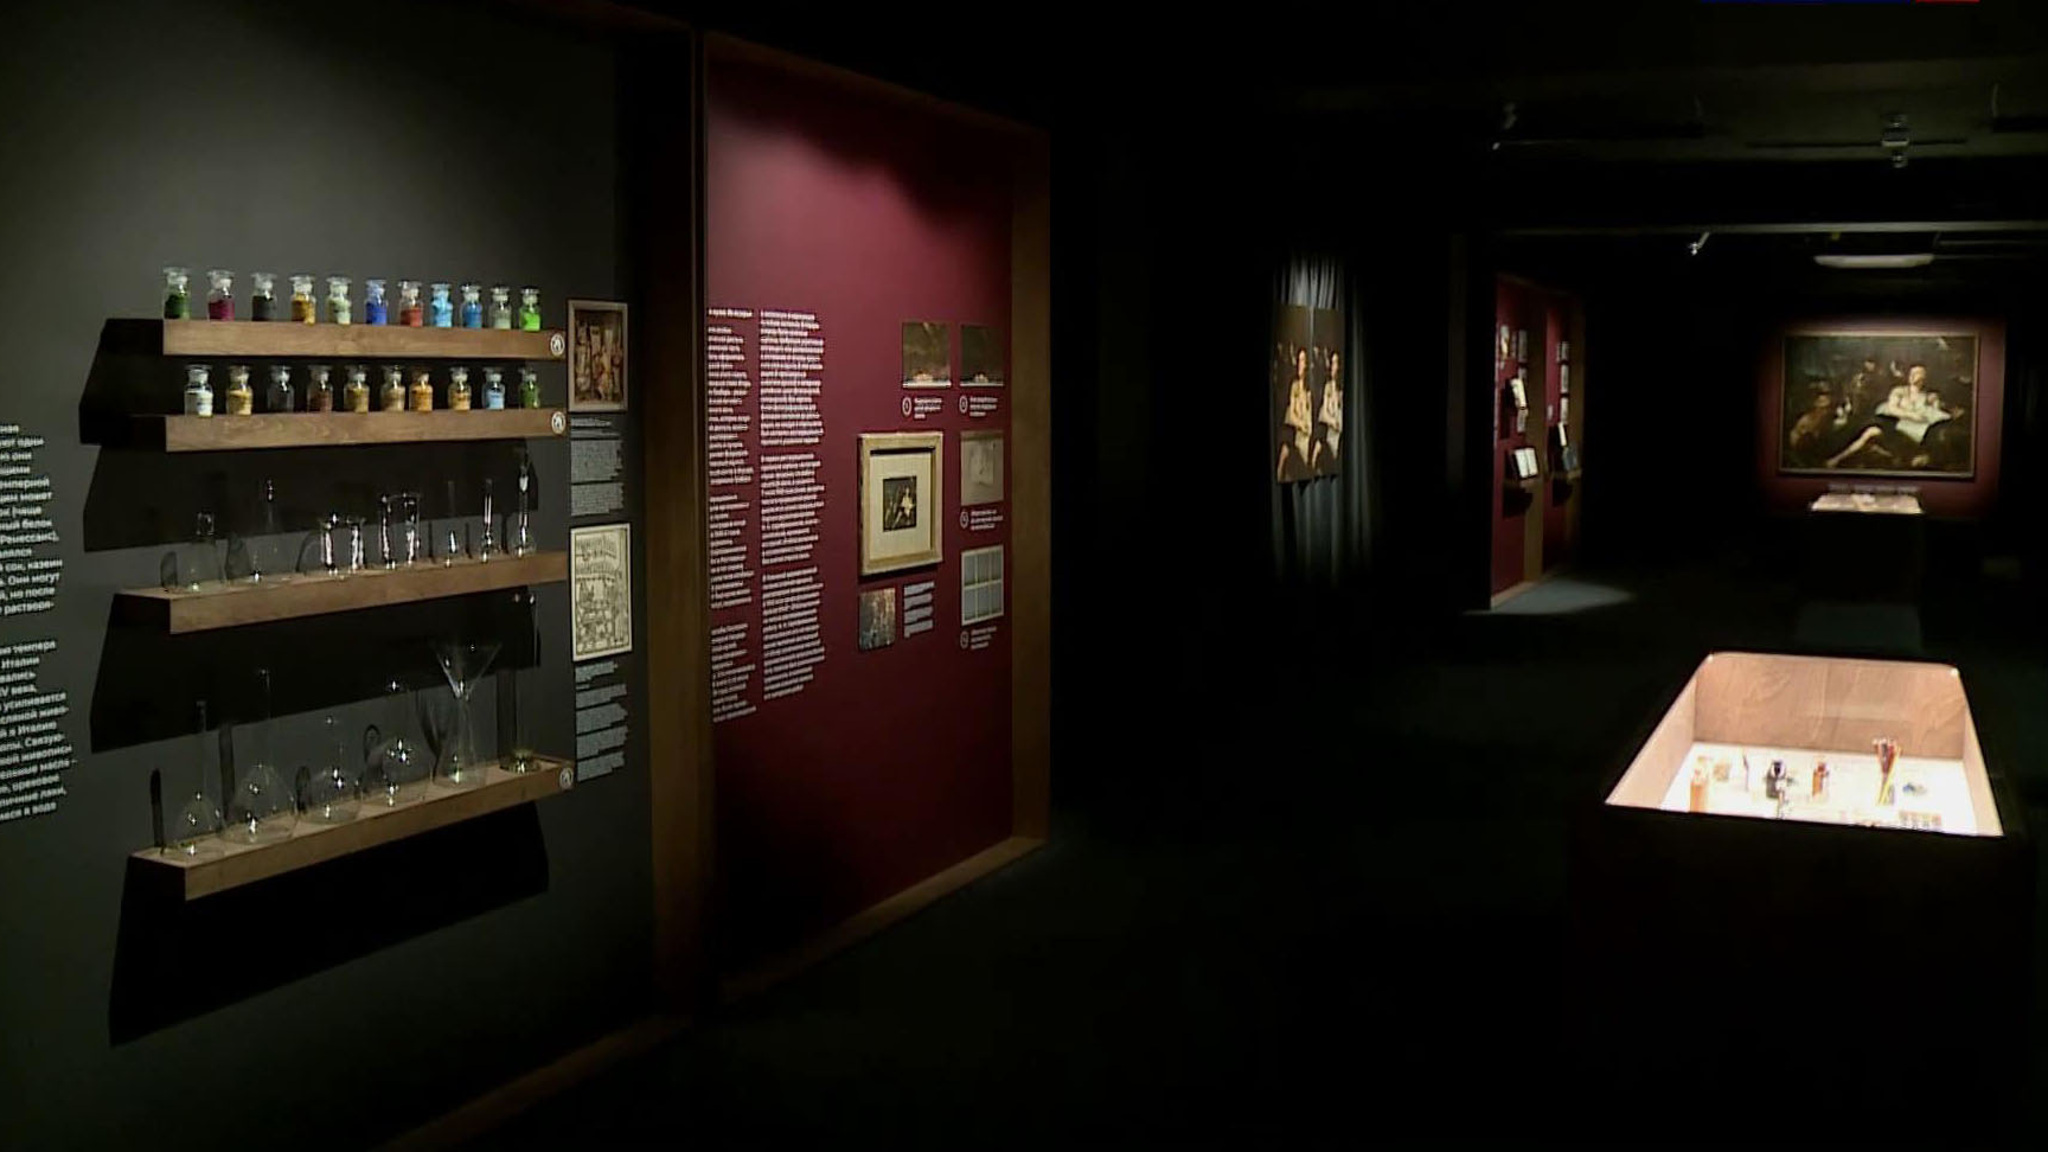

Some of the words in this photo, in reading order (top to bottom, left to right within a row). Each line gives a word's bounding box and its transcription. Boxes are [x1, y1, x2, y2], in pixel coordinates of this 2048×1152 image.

[20, 492, 53, 502] может
[22, 518, 53, 529] белок
[27, 559, 63, 570] казеин
[7, 575, 30, 586] Они
[31, 572, 60, 585] могут
[25, 587, 55, 598] после
[1, 657, 40, 669] Италии
[3, 692, 67, 713] усиливается
[21, 743, 73, 761] живописи
